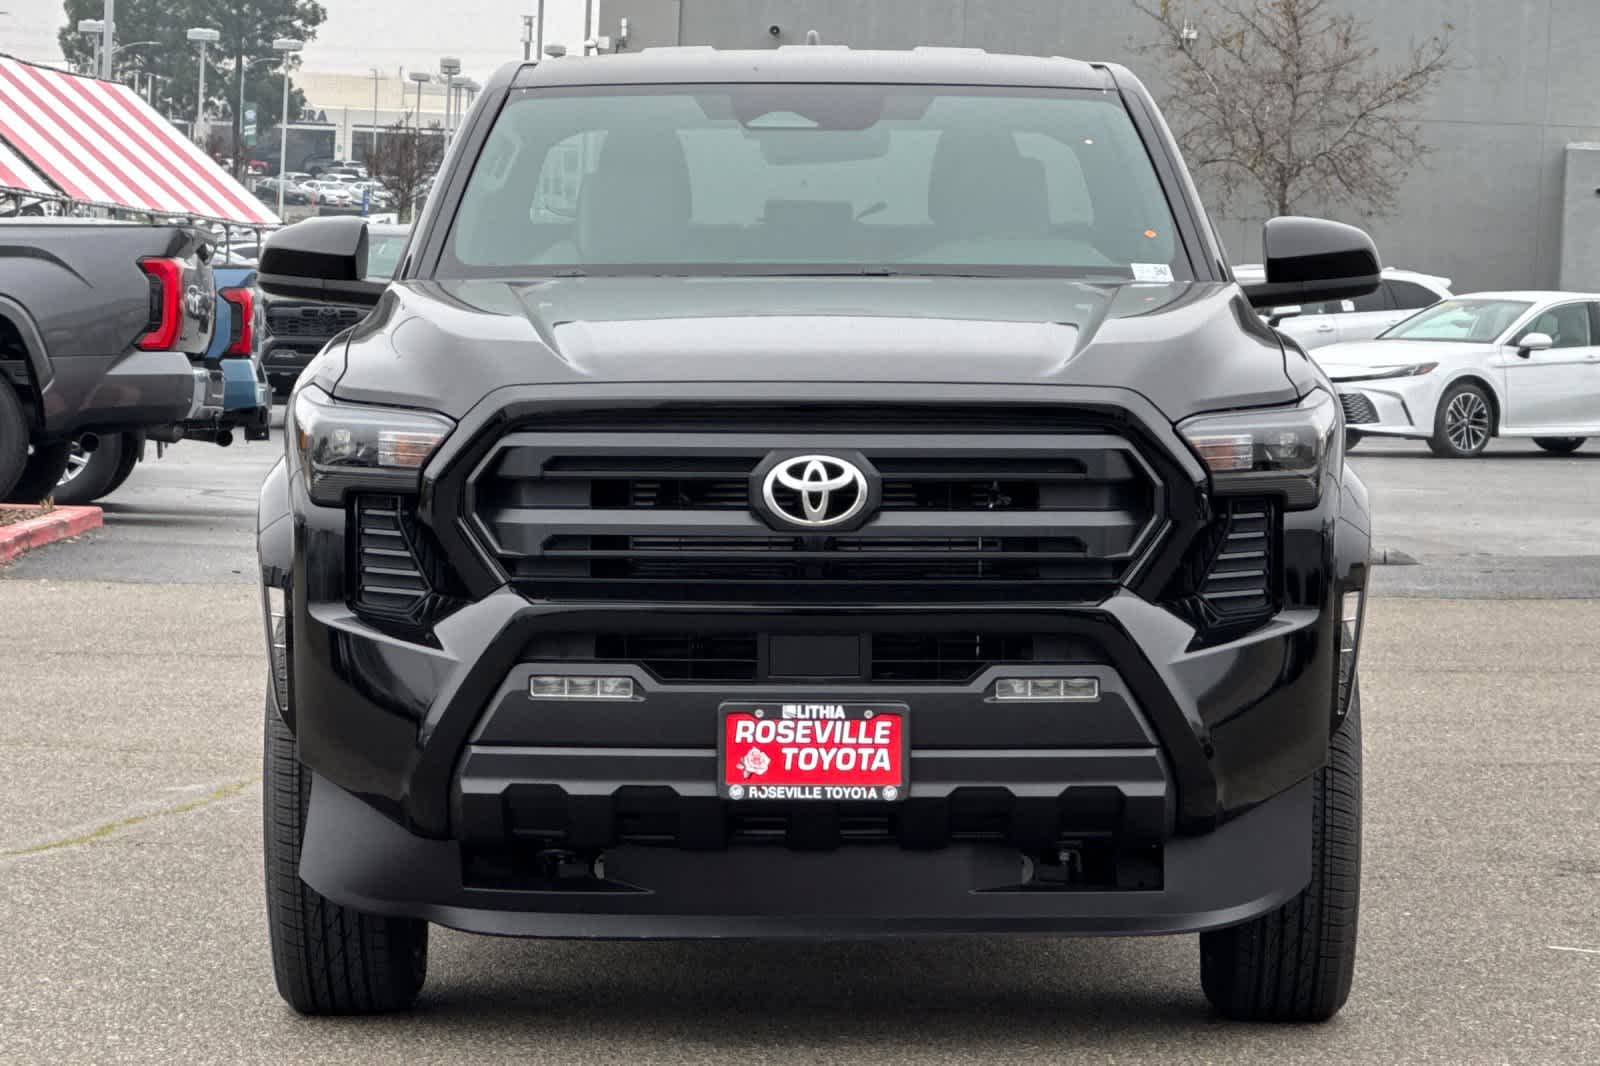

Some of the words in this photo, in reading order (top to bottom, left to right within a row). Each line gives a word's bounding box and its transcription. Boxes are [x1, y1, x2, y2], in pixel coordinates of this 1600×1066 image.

[797, 705, 846, 719] LITHIA
[735, 720, 893, 744] ROSEVILLE
[781, 747, 891, 771] TOYOTA
[748, 786, 822, 799] ROSEVILLE
[824, 786, 878, 799] TOYOTA
